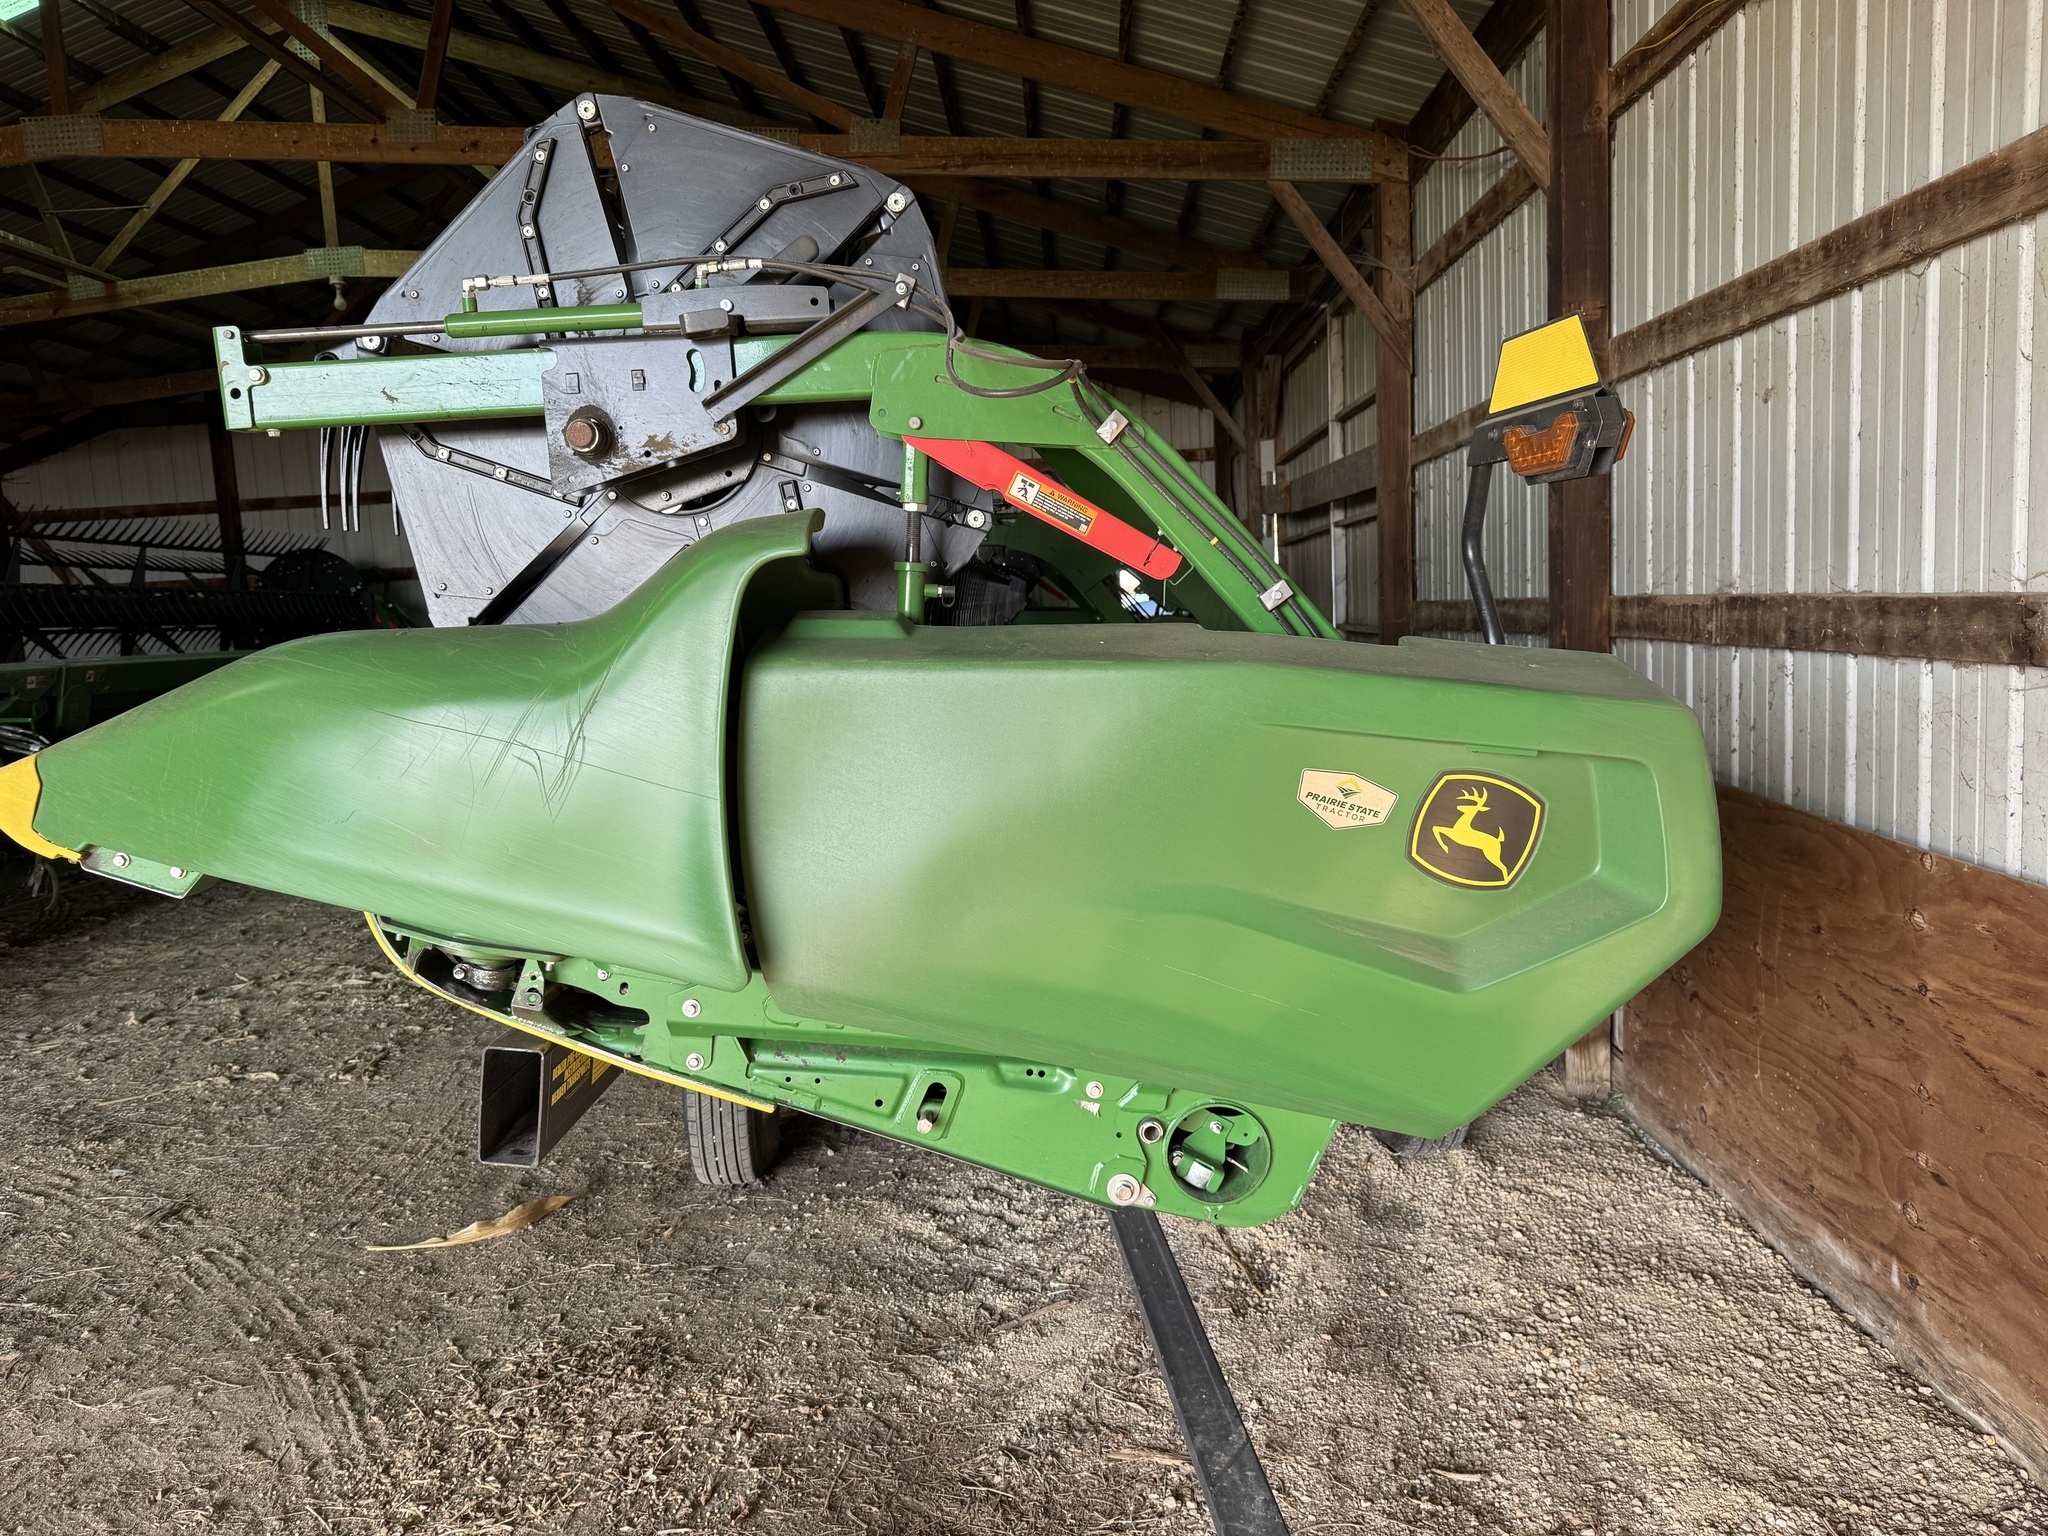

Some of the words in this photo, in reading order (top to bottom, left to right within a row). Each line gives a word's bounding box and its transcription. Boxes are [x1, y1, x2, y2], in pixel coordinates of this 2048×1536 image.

[1057, 493, 1088, 514] WARNING
[1305, 791, 1348, 809] PRAIRIE
[1348, 803, 1381, 818] STATE
[1316, 802, 1366, 823] TRACTOR
